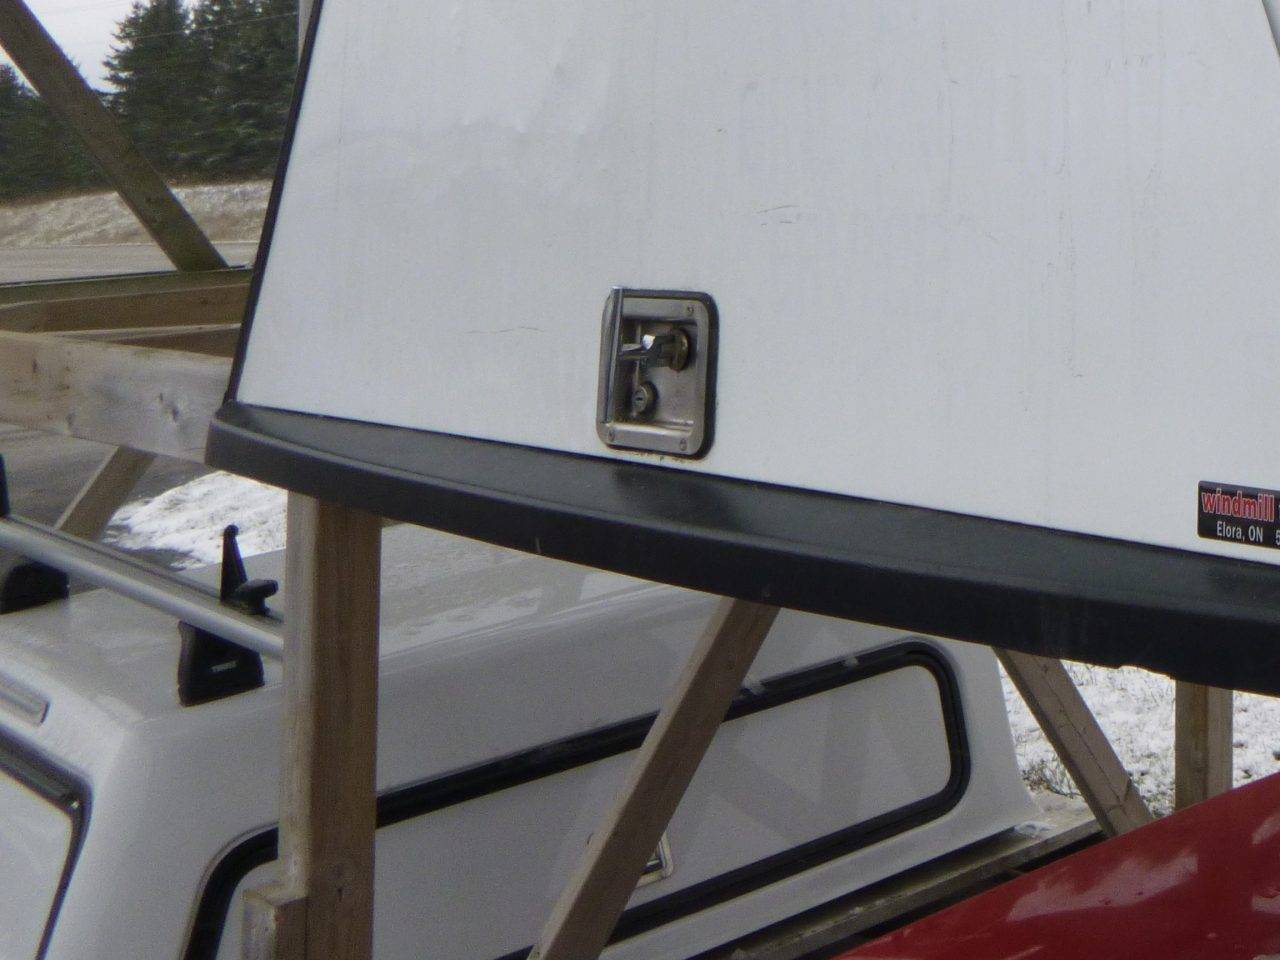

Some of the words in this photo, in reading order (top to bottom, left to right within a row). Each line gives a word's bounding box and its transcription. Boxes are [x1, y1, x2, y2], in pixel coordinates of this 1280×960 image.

[1202, 488, 1275, 522] windmill
[1216, 521, 1245, 541] Elora,
[1248, 526, 1263, 542] ON
